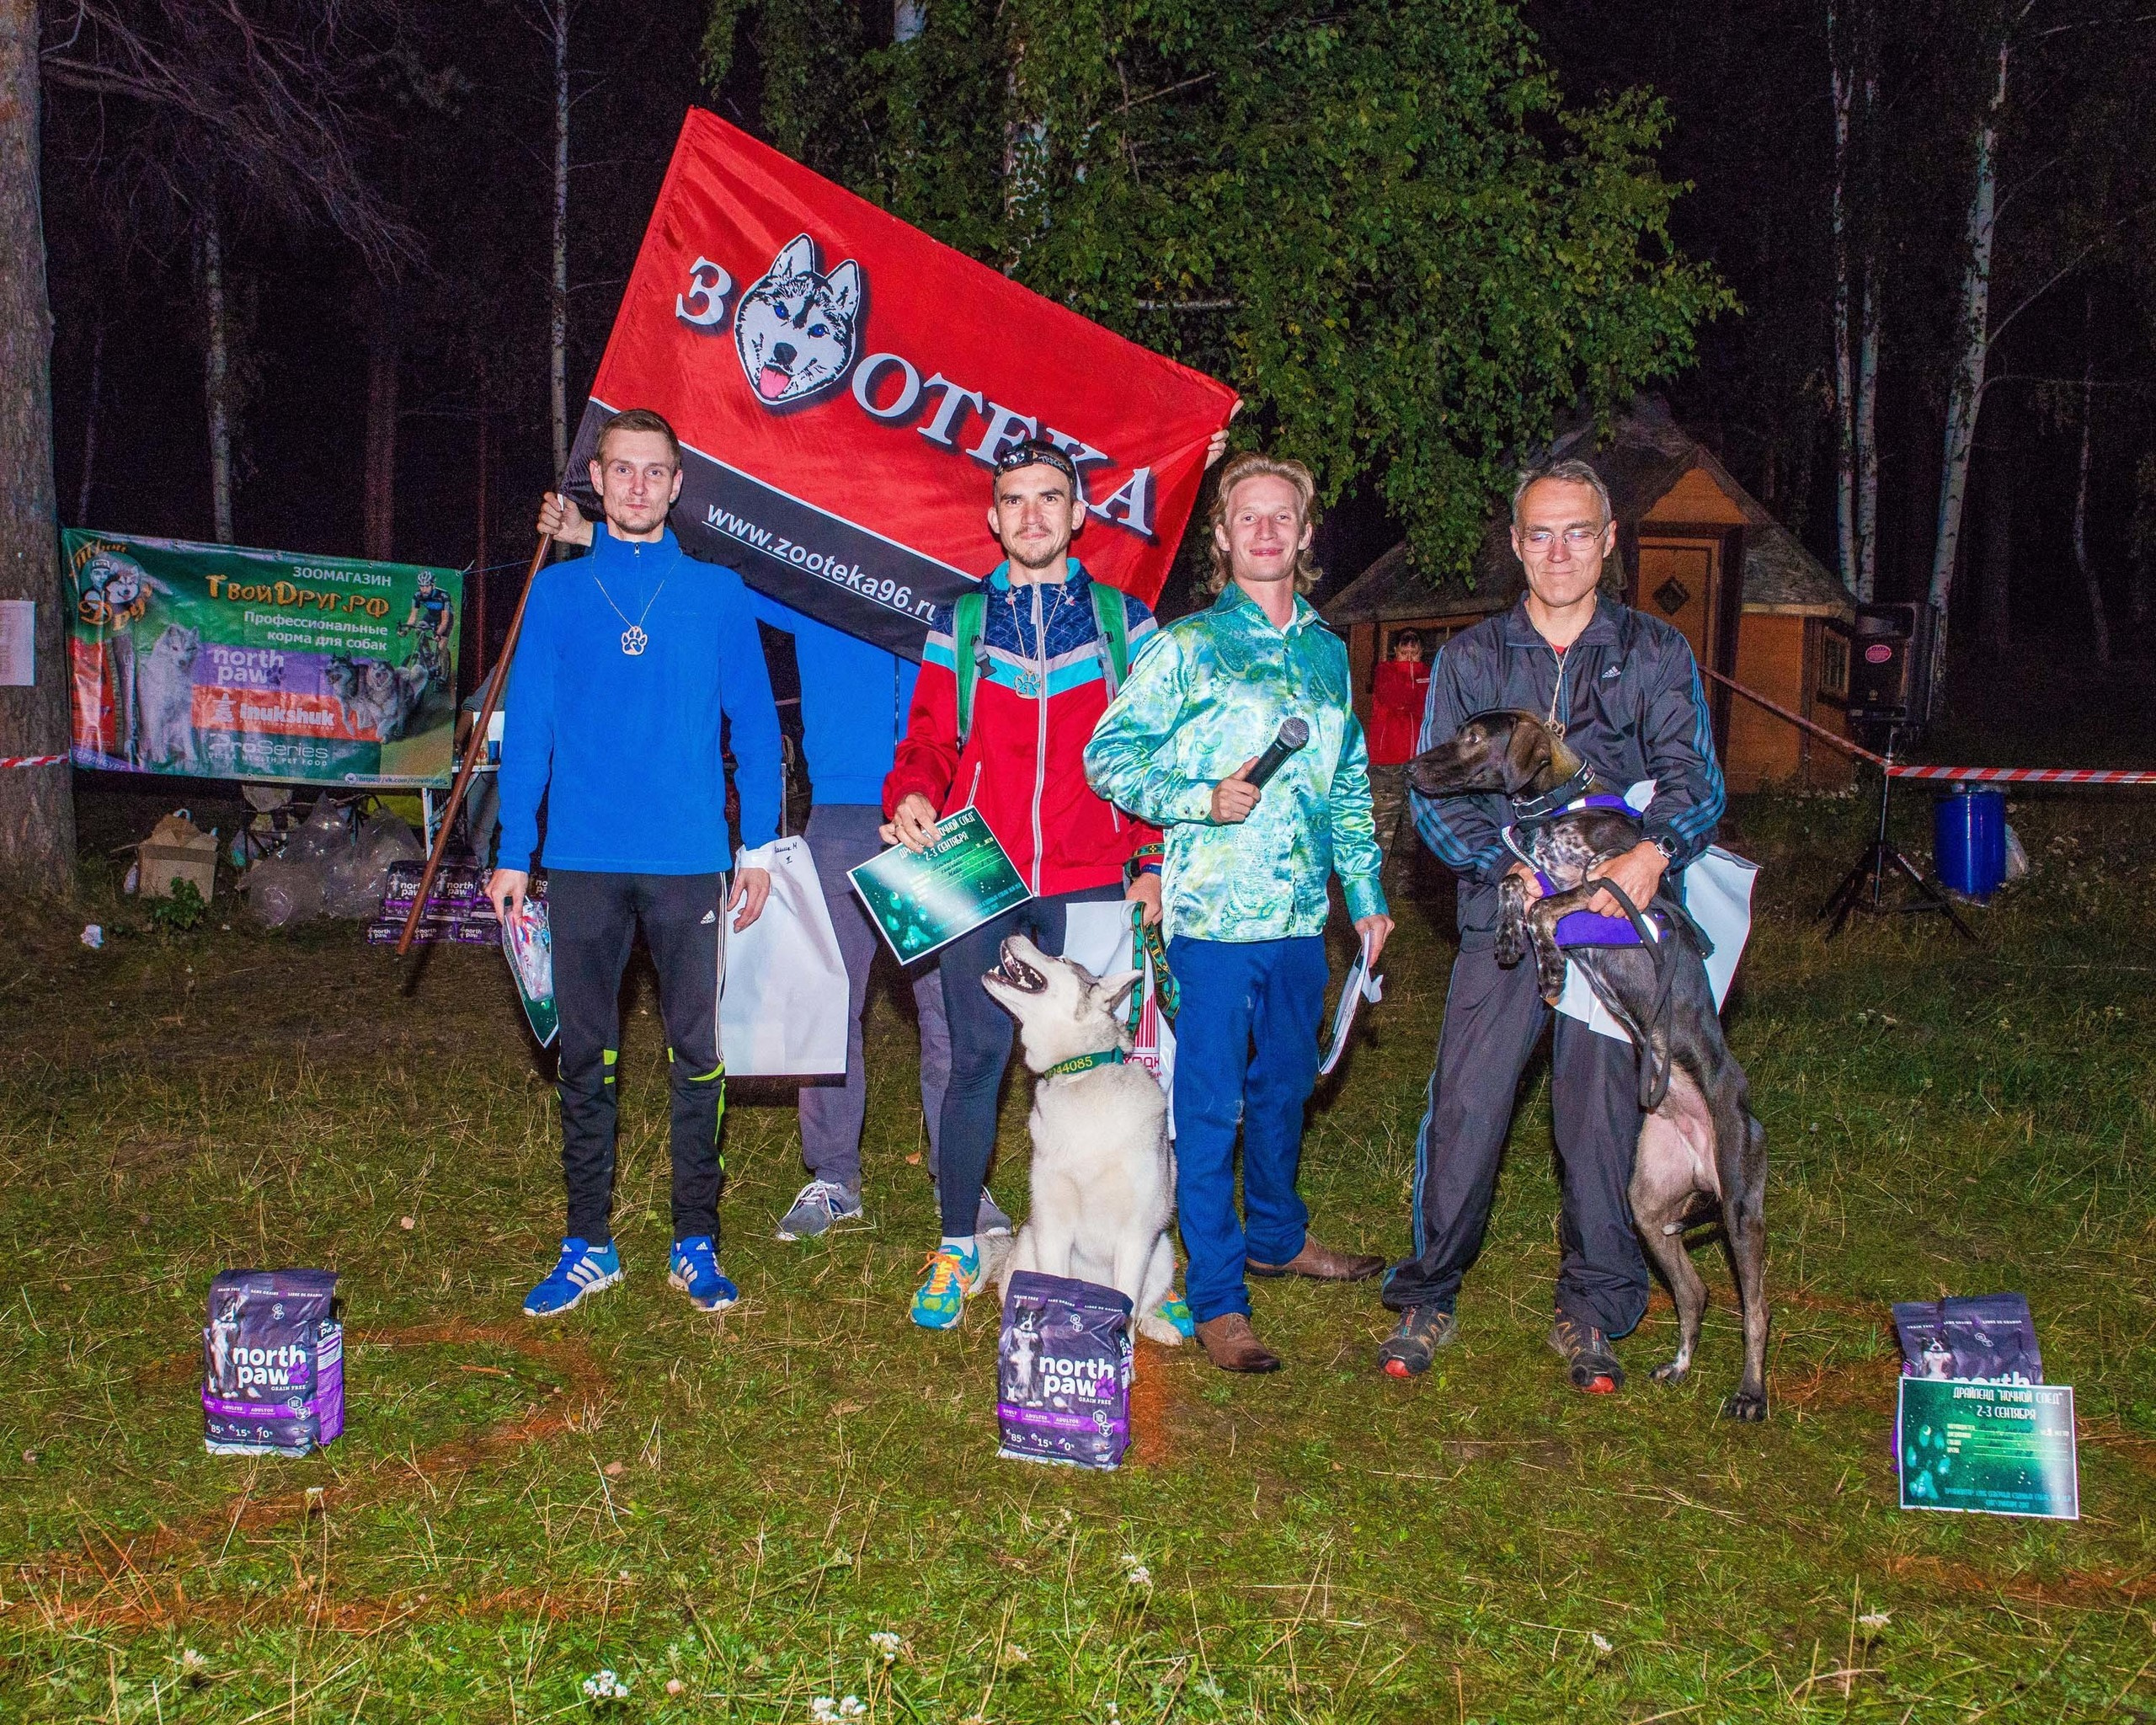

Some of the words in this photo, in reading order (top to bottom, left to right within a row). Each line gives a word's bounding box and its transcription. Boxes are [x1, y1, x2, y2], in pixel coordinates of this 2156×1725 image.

[708, 504, 937, 622] www.zooteka96.ru
[293, 566, 392, 587] ЗООМАГАЗИН
[244, 611, 388, 636] Профессиональные
[267, 631, 312, 645] корма
[315, 636, 342, 648] для
[345, 637, 387, 651] собак
[213, 649, 285, 668] north
[217, 665, 268, 685] paw
[240, 702, 335, 727] Inukshuk
[923, 847, 938, 861] 2-3
[937, 830, 969, 853] СЕНТЯБРЯ
[446, 881, 473, 889] north
[447, 888, 467, 896] paw
[232, 1345, 307, 1366] north
[238, 1366, 290, 1388] paw
[1039, 1356, 1115, 1380] north
[1043, 1374, 1097, 1398] paw
[1953, 1386, 1995, 1402] ДРАЙЛЕНД
[1977, 1405, 1993, 1417] 2-3
[1994, 1406, 2036, 1420] СЕНТЯБРЯ
